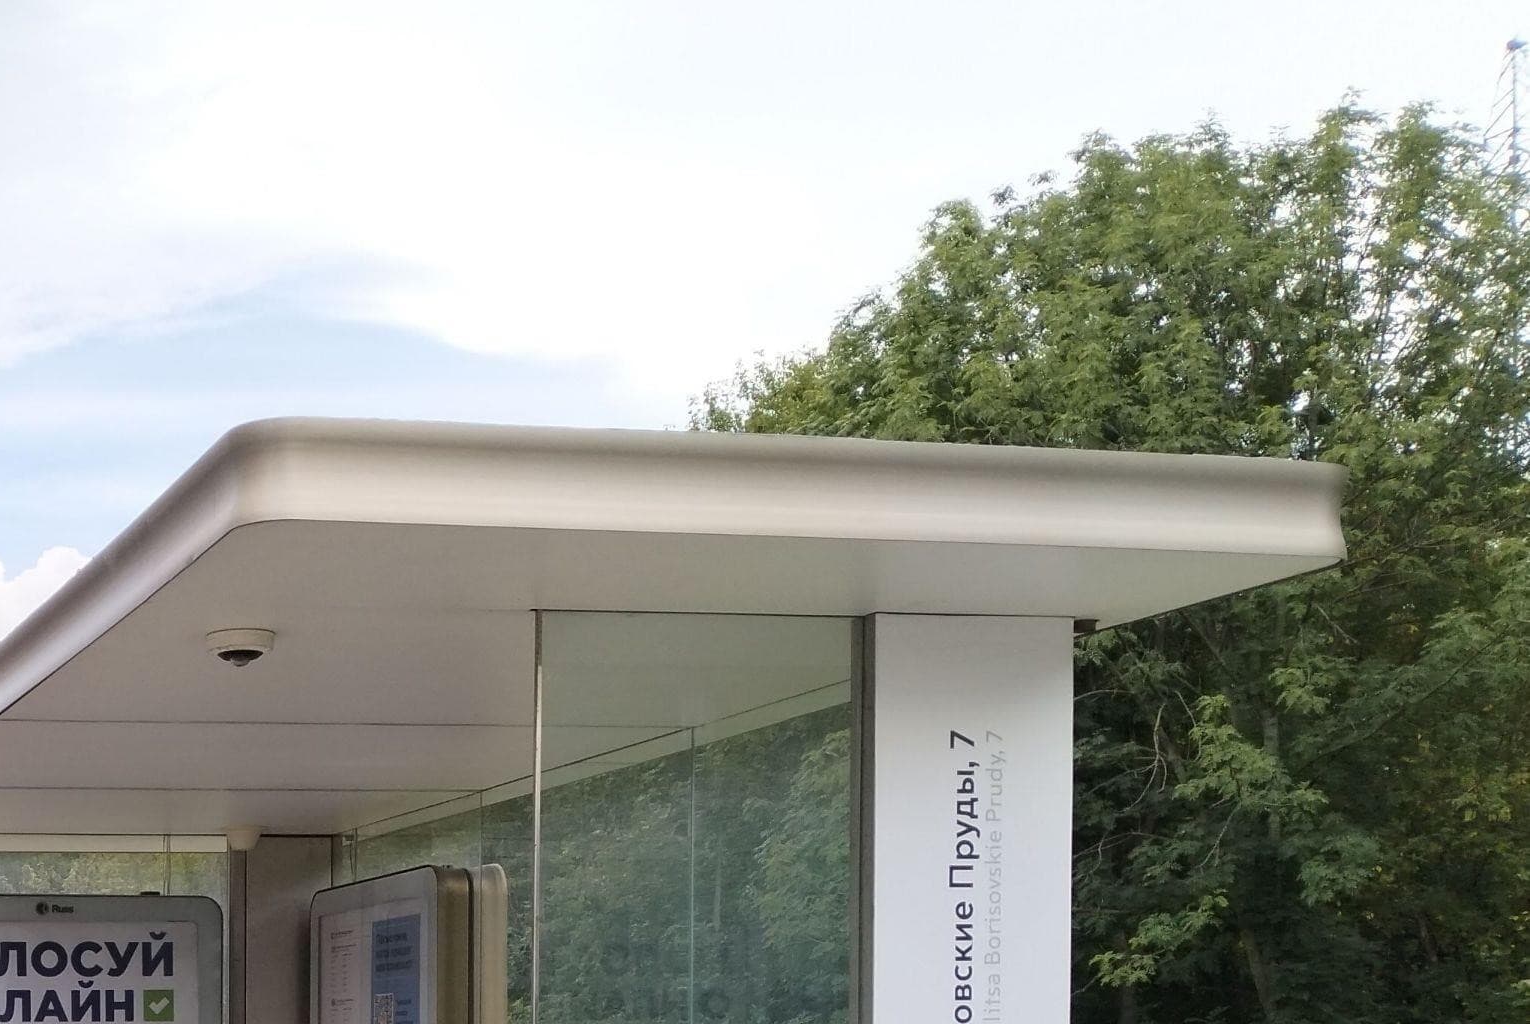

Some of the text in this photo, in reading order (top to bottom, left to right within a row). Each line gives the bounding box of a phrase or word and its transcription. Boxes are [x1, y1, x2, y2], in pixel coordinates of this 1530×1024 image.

[950, 730, 975, 749] 7
[986, 730, 1003, 743] 7
[985, 751, 1007, 821] Prudy,
[949, 761, 981, 888] Пруды,
[51, 904, 74, 914] Russ
[984, 830, 1003, 965] Borisovskie
